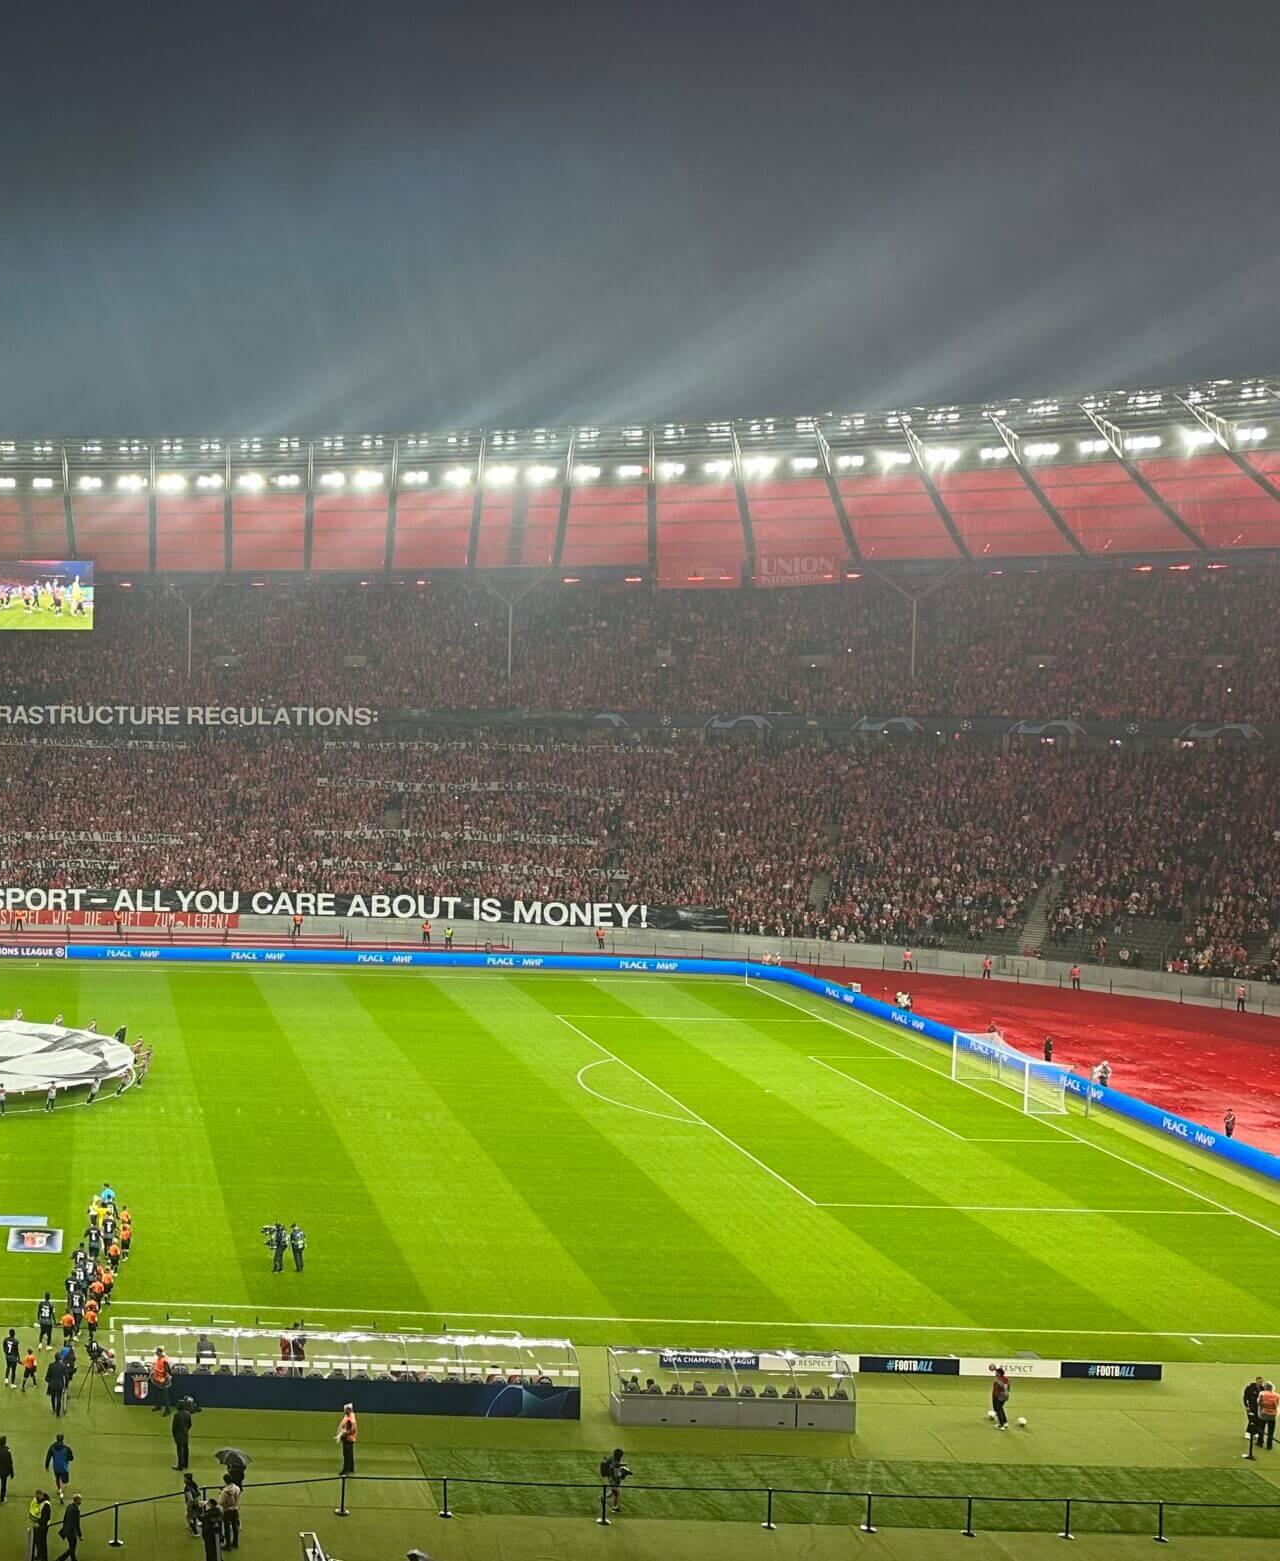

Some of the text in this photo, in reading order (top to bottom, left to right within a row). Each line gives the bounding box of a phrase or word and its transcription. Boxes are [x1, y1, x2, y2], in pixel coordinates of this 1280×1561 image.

[760, 556, 835, 575] UNION
[187, 706, 379, 726] REGULATIONS:
[371, 831, 406, 840] MEDIA
[382, 862, 395, 870] OF
[114, 889, 171, 912] ALL
[176, 890, 246, 914] YOU
[251, 892, 337, 916] CARE
[346, 894, 462, 919] ABOUT
[473, 897, 502, 922] IS
[513, 900, 648, 929] MONEY!
[52, 910, 73, 925] WIE
[83, 911, 102, 925] DIE
[154, 912, 176, 927] ZUM
[187, 913, 229, 929] LEBEN!
[21, 948, 53, 957] LEAGUE
[106, 949, 132, 957] PEACE
[231, 951, 257, 960] PEACE
[357, 954, 385, 962] PEACE
[487, 957, 513, 965] PEACE
[619, 961, 648, 969] PEACE
[890, 1011, 908, 1024] PEACE
[1162, 1117, 1216, 1148] PEACE МИР
[886, 1359, 934, 1372] #FOOTBALL
[1087, 1364, 1135, 1378] #FOOTBALL
